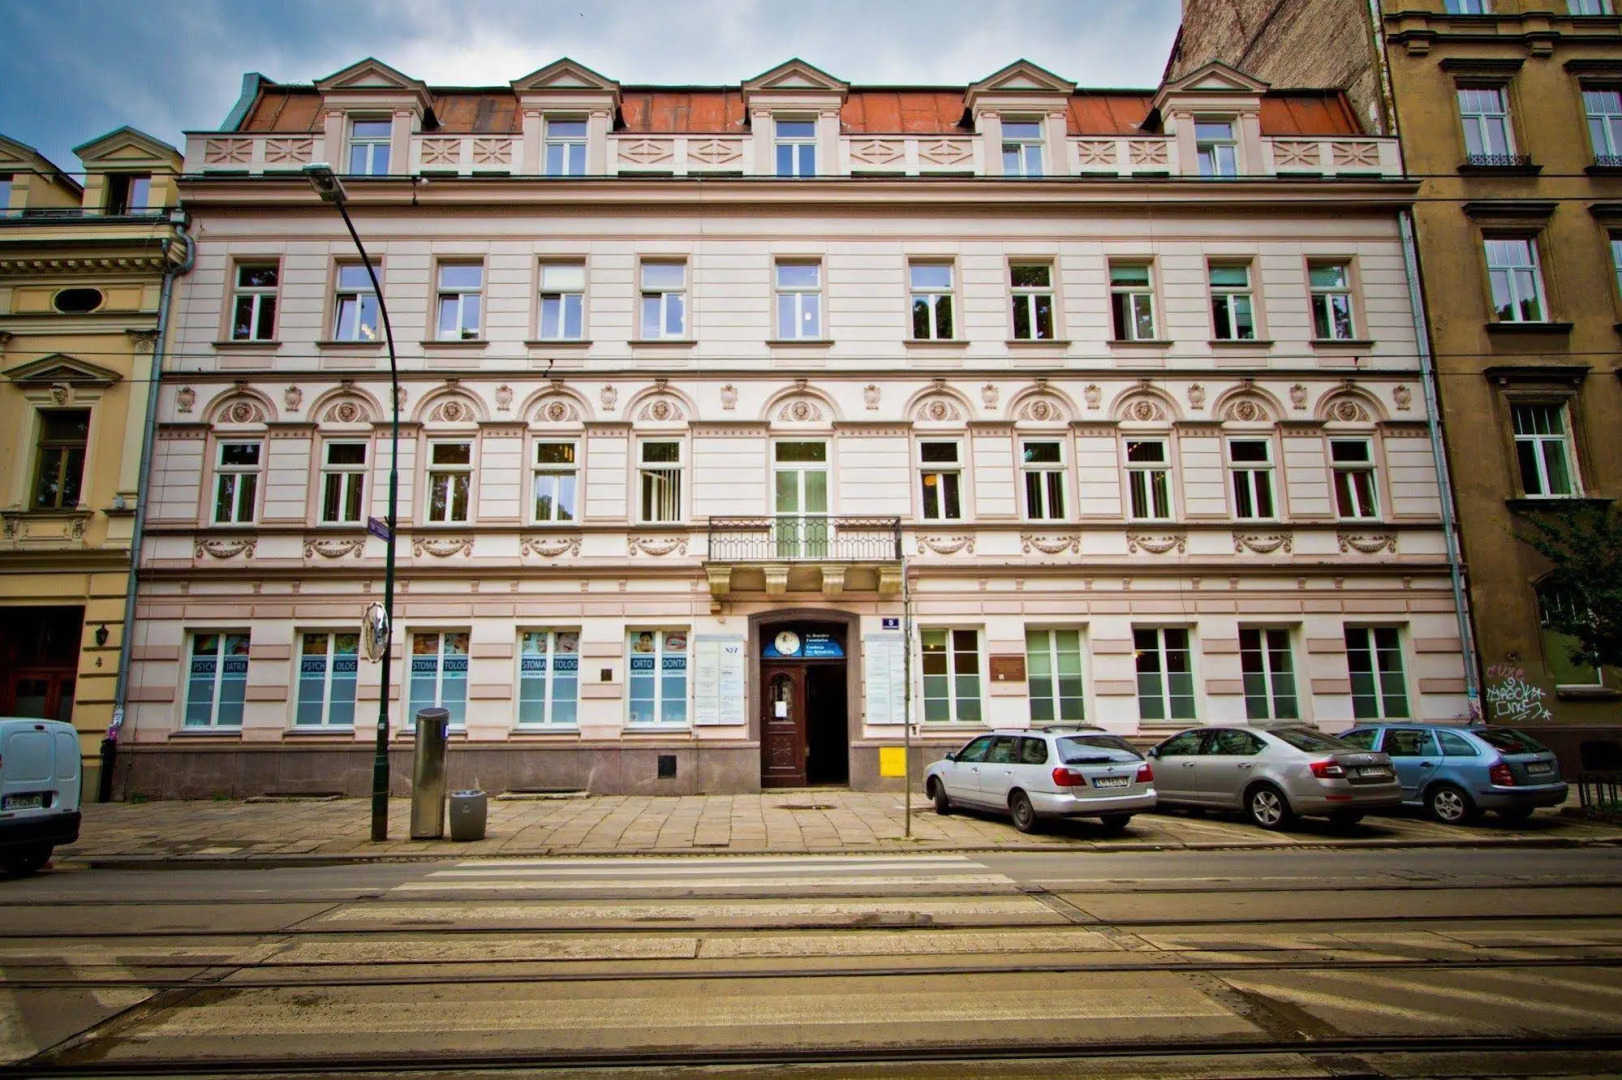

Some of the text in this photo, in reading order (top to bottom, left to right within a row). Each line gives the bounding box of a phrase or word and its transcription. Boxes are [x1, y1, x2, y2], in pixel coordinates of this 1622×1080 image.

[193, 662, 216, 671] PSYCH
[303, 661, 356, 671] PSYCH OLOG
[412, 661, 468, 670] STOMA TOLOG
[522, 660, 578, 669] STOMA TOLOG
[633, 659, 686, 668] ORTO DONTA
